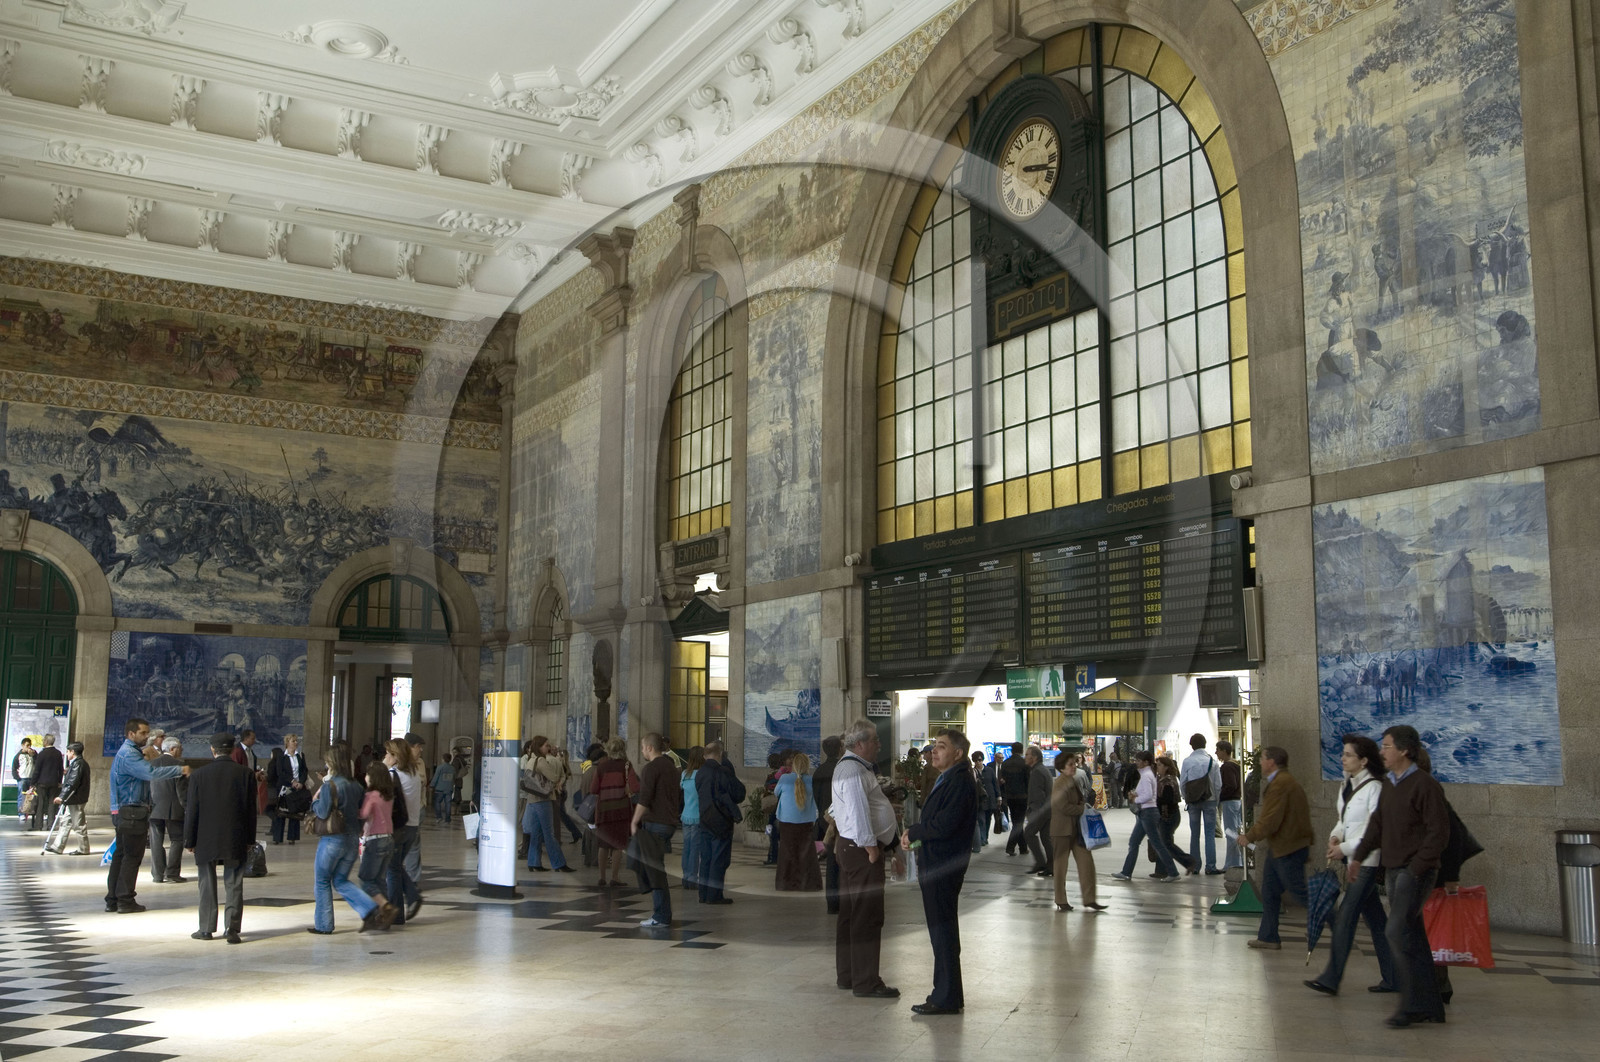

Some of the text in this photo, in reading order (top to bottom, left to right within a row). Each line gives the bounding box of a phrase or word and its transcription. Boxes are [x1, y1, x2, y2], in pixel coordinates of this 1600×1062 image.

[1044, 136, 1054, 149] II
[1048, 152, 1057, 164] III
[1006, 284, 1056, 323] PORTO
[1106, 492, 1176, 513] Chegadas Arrivals
[923, 539, 946, 551] Partidas
[678, 541, 717, 563] ENTRADA
[1144, 591, 1161, 601] 15528
[1144, 603, 1162, 613] 15828
[1076, 671, 1088, 686] C1
